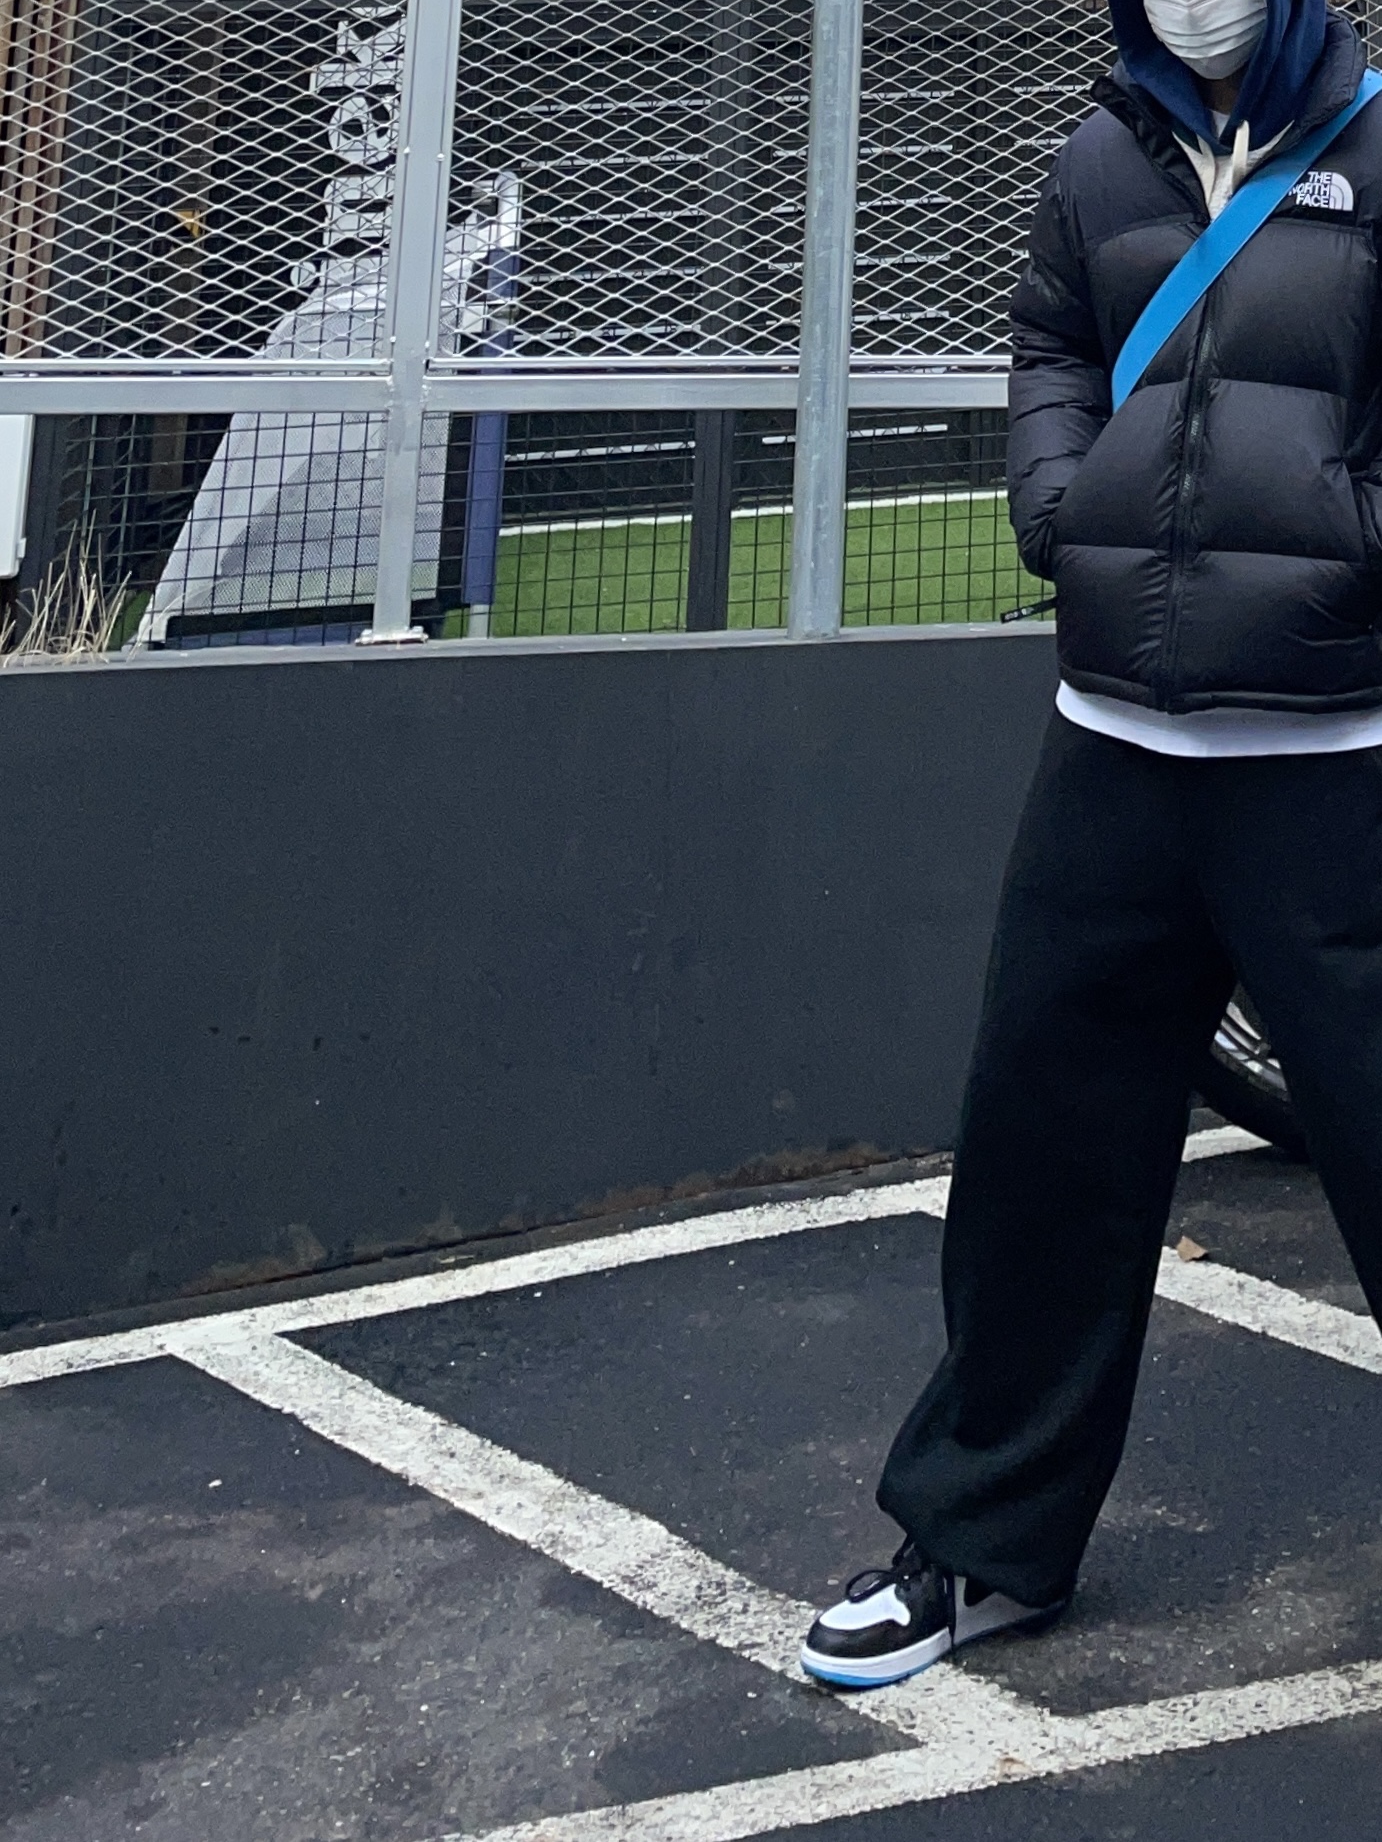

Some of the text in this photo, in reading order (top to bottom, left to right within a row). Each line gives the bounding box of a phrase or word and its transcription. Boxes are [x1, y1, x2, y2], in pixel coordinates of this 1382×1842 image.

[1307, 171, 1331, 184] THE
[1288, 182, 1330, 197] NORTH
[1295, 194, 1329, 208] FACE
